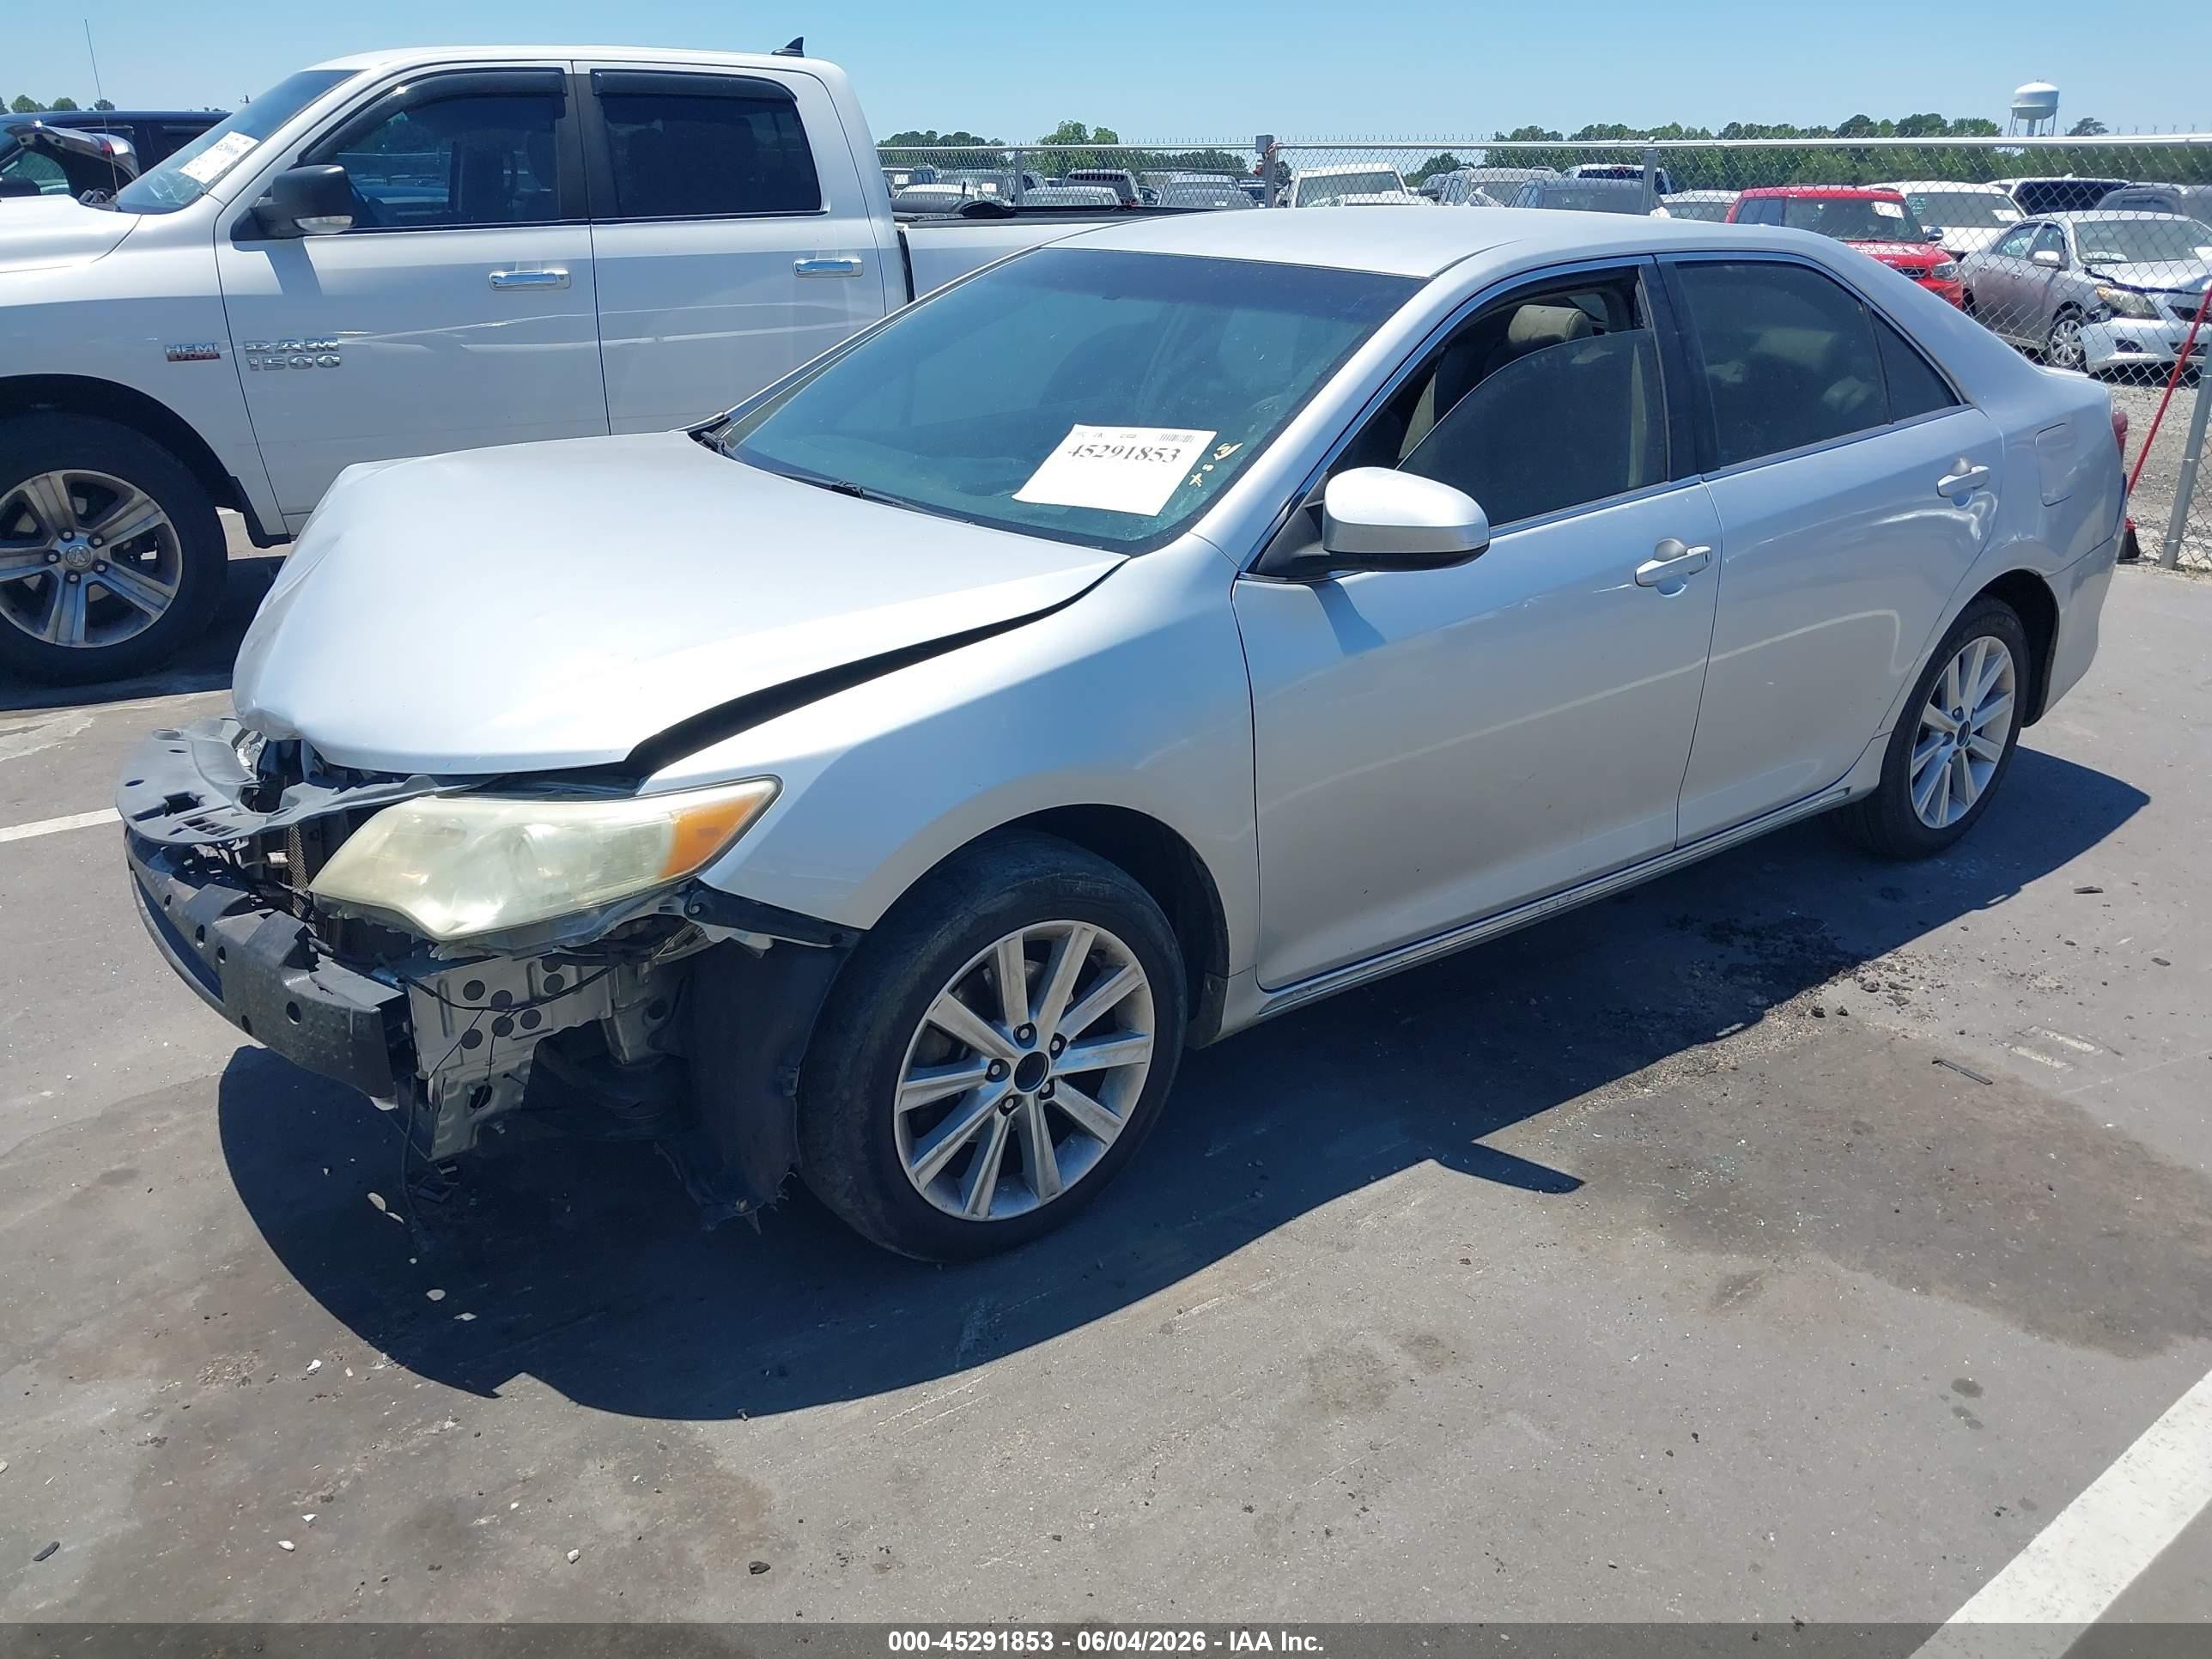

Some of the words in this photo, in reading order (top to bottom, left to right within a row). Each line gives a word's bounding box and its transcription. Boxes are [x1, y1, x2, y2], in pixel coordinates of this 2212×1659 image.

[164, 343, 219, 353] HEMI
[244, 337, 340, 354] RAM
[247, 355, 341, 371] 1500
[1067, 443, 1182, 464] 45291853
